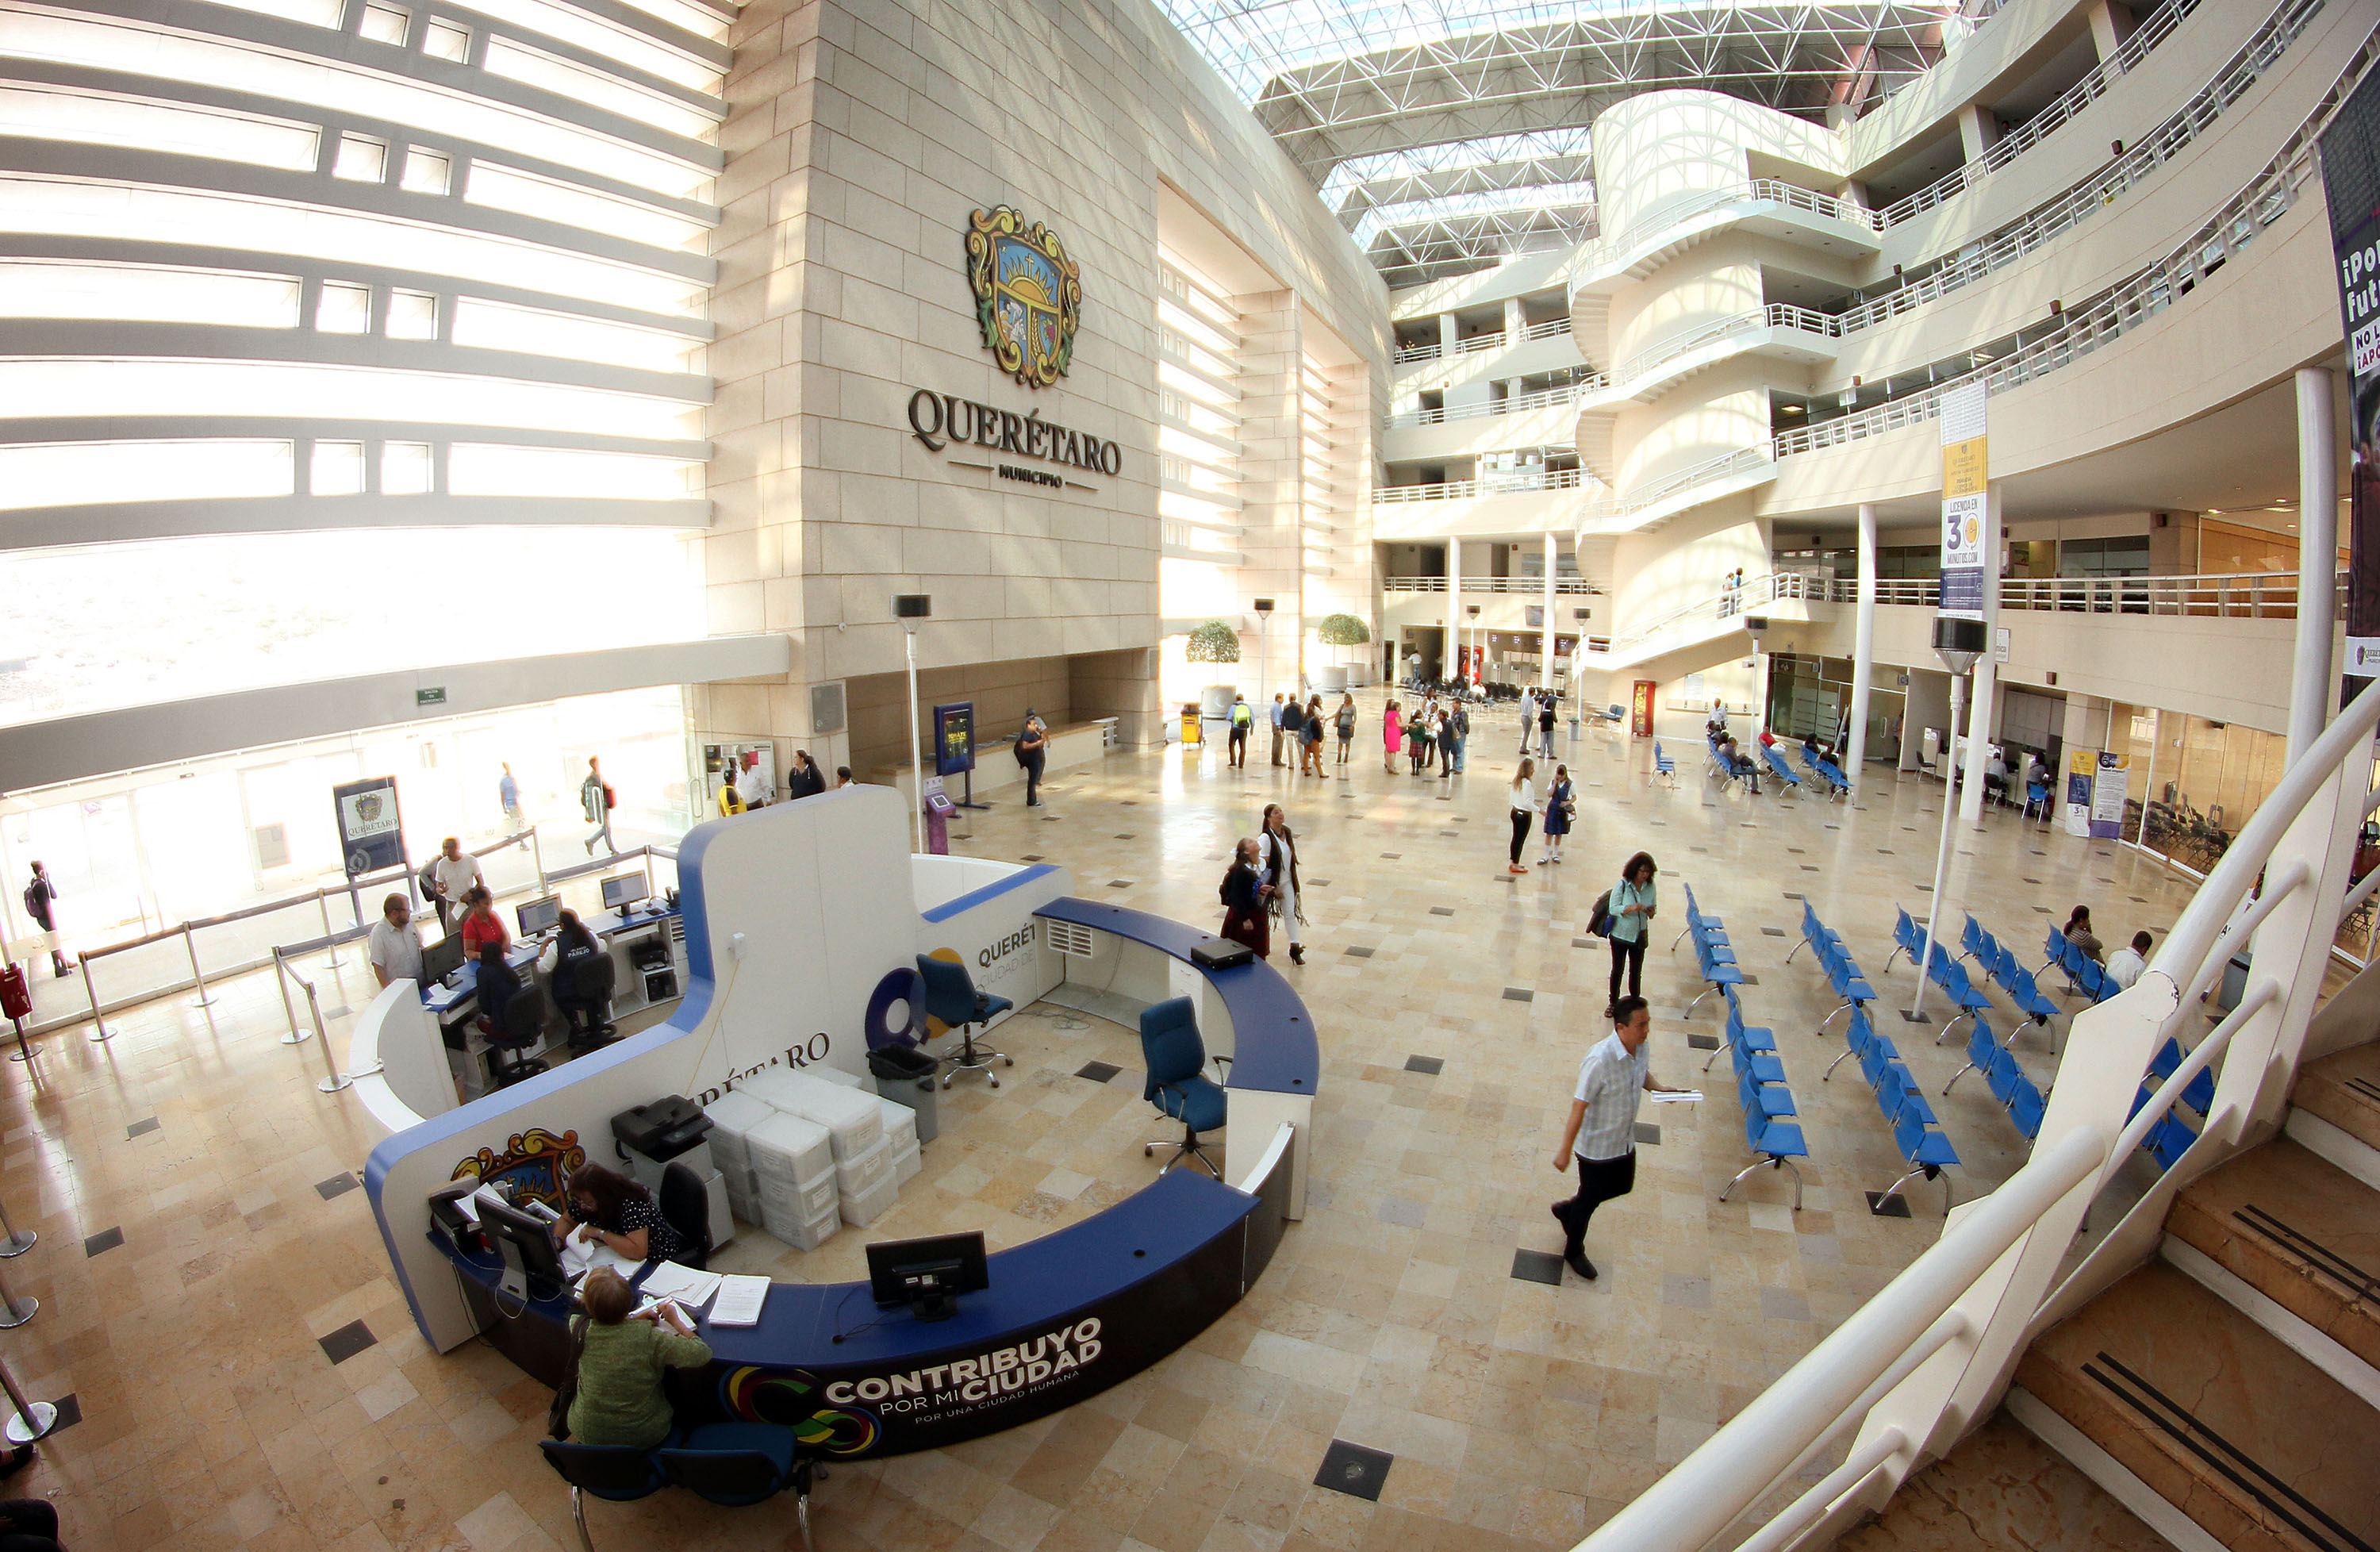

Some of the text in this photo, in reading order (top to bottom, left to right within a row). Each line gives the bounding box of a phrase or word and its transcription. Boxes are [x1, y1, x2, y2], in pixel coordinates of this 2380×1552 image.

[2347, 279, 2380, 323] fut
[2355, 330, 2370, 350] NO
[908, 389, 1123, 476] QUERÉTARO
[999, 464, 1063, 488] MUNICIPIO
[1949, 498, 1978, 513] LICENCIA EN
[1947, 551, 1979, 564] MINUTOS.COM
[567, 948, 590, 958] PAREJO
[1021, 949, 1035, 966] DE
[826, 1317, 1101, 1404] CONTRIBUYO
[880, 1339, 1102, 1416] POR MI CIUDAD
[915, 1370, 1080, 1424] POR UNA CIUDAD HUMANA
